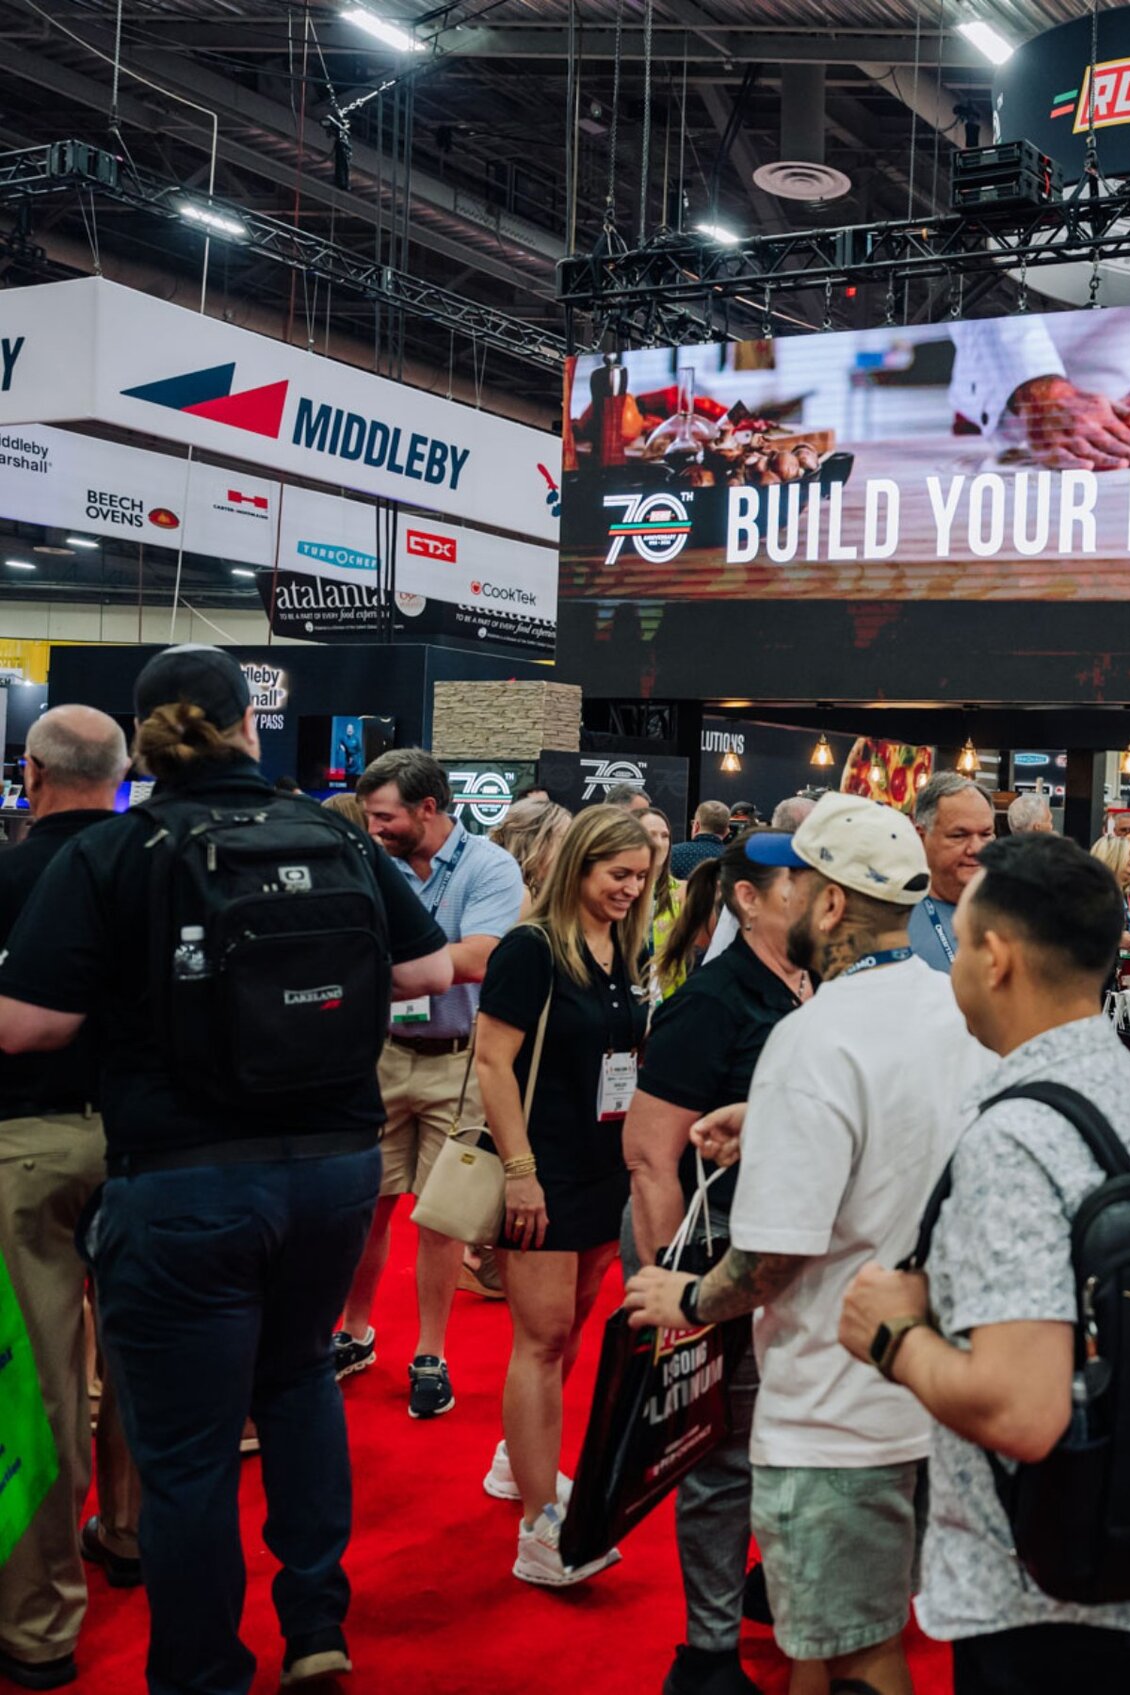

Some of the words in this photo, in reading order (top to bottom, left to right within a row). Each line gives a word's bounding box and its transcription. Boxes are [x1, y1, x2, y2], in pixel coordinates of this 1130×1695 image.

[292, 397, 470, 490] MIDDLEBY
[87, 489, 143, 513] BEECH
[85, 505, 144, 528] OVENS
[726, 478, 900, 563] BUILD
[926, 469, 1098, 558] YOUR
[409, 535, 453, 558] CTX
[482, 582, 537, 606] CookTek
[260, 714, 285, 730] PASS
[701, 730, 745, 755] LUTIONS
[284, 986, 343, 1004] LAKELAND
[671, 1340, 707, 1379] GOING
